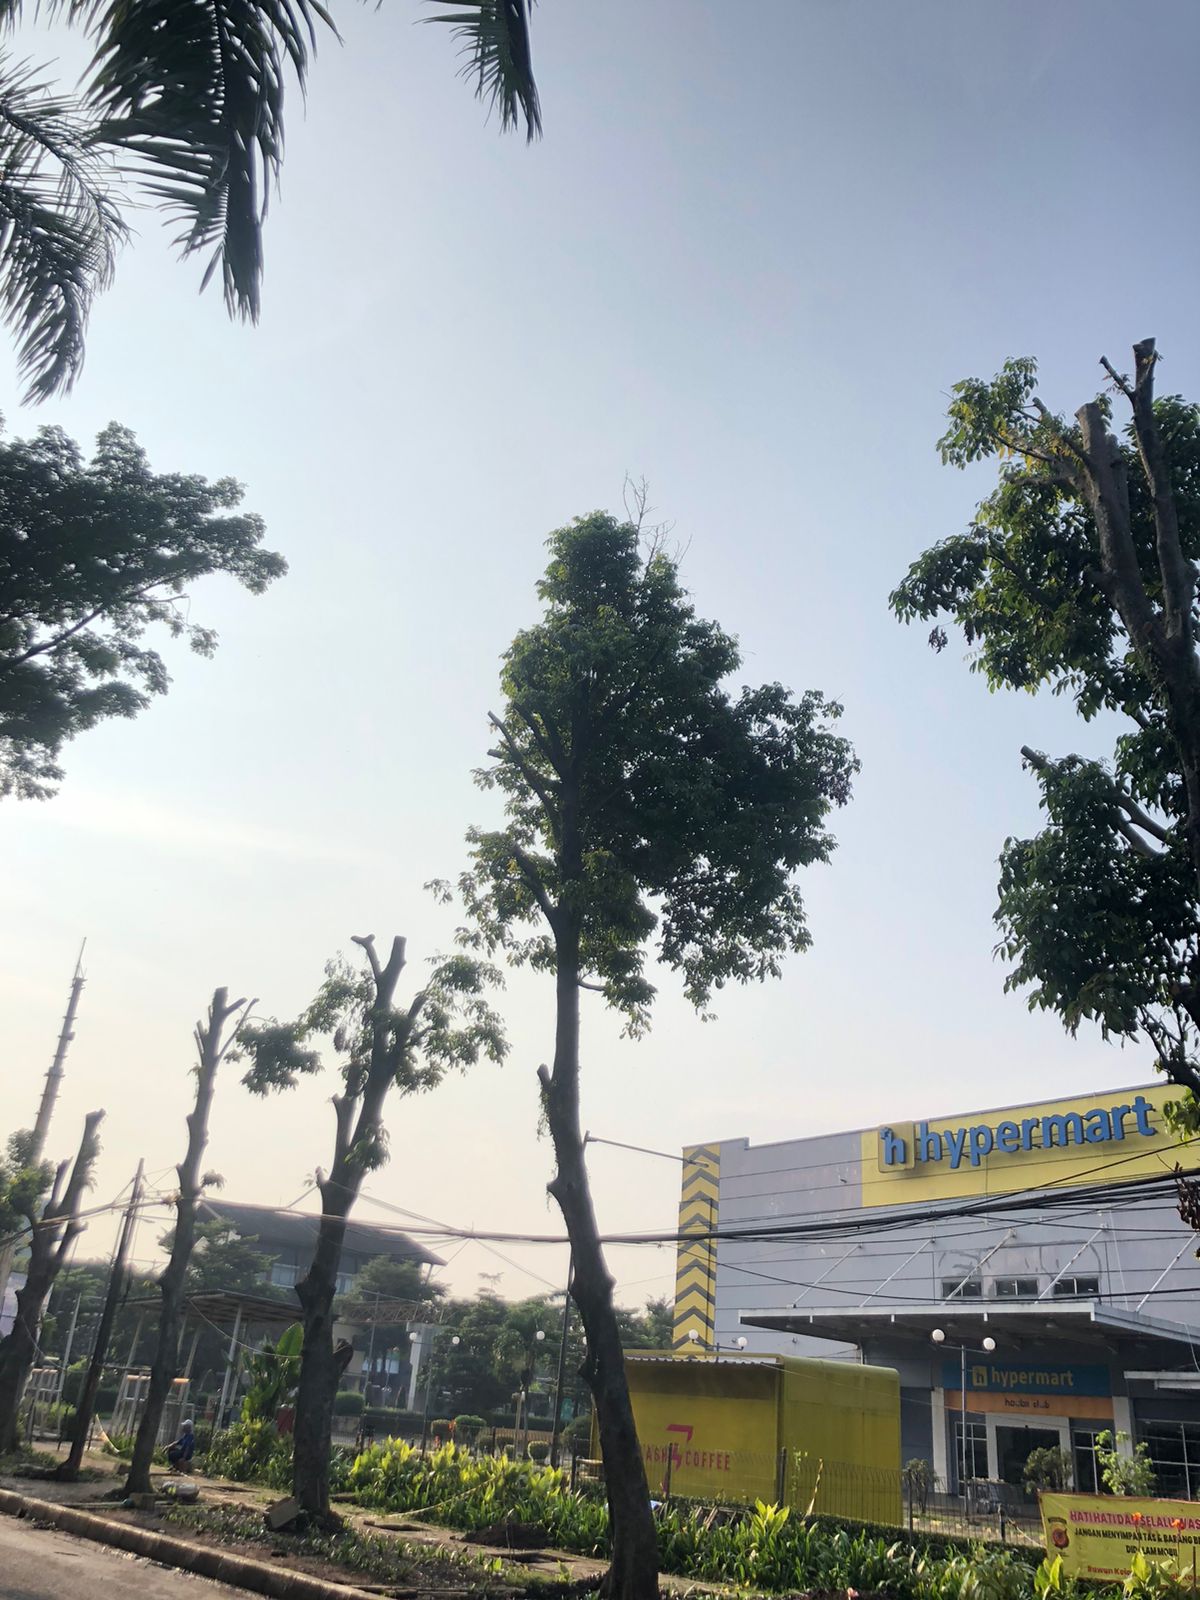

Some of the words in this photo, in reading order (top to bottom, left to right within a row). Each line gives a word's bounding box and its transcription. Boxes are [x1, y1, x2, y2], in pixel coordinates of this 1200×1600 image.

[919, 1096, 1158, 1169] hypermart
[991, 1366, 1074, 1388] hypermart
[685, 1450, 731, 1472] COFFEE
[1117, 1514, 1139, 1526] DA
[1125, 1545, 1156, 1556] DIDLAM
